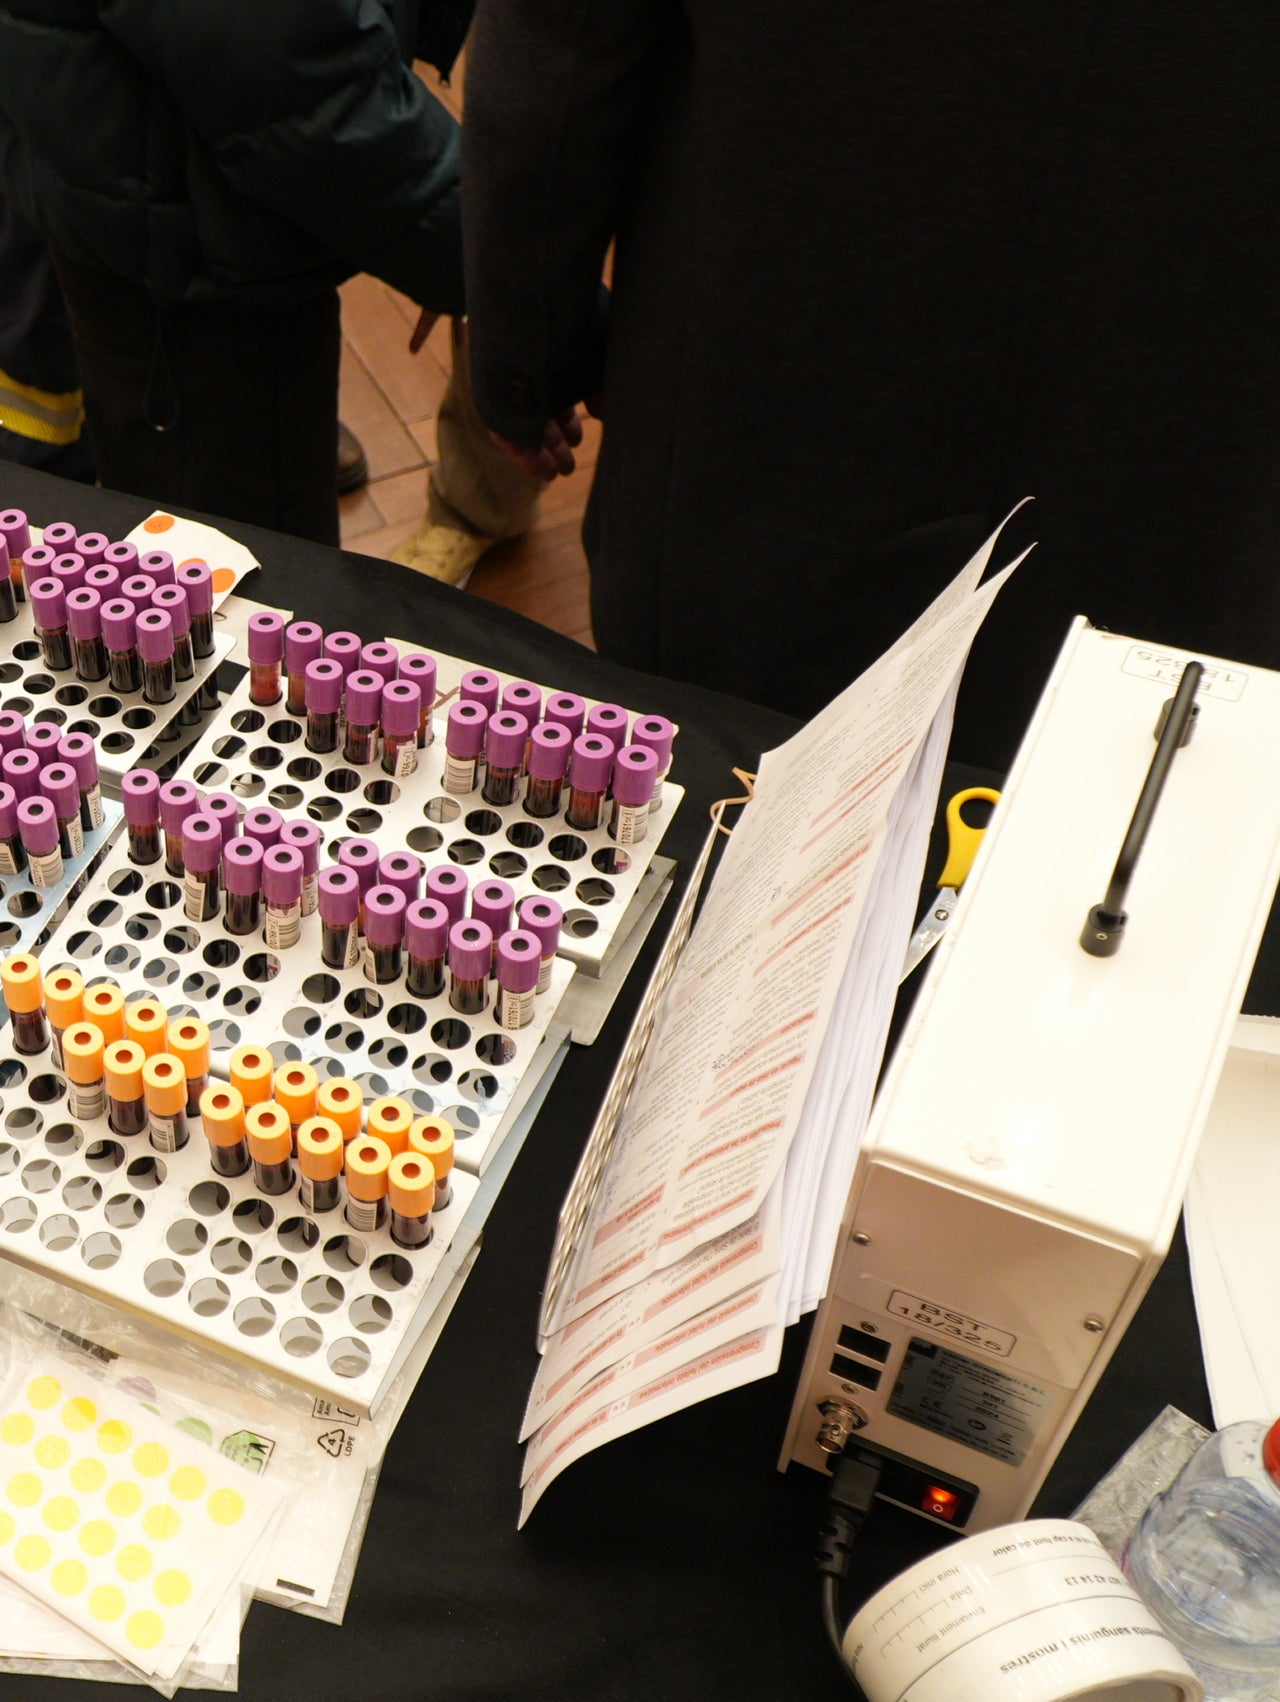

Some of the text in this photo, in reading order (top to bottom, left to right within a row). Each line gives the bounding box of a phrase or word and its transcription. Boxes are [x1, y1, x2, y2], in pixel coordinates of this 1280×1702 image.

[921, 1303, 987, 1331] BST
[899, 1306, 1001, 1351] 18/325
[328, 1438, 336, 1446] 4
[345, 1436, 355, 1457] LDPE
[992, 1544, 1017, 1557] calor
[937, 1566, 960, 1581] Hora
[950, 1586, 973, 1602] Data
[916, 1606, 986, 1653] Enviament lliurat
[1070, 1627, 1131, 1647] sanguinis
[999, 1642, 1060, 1674] mostres
